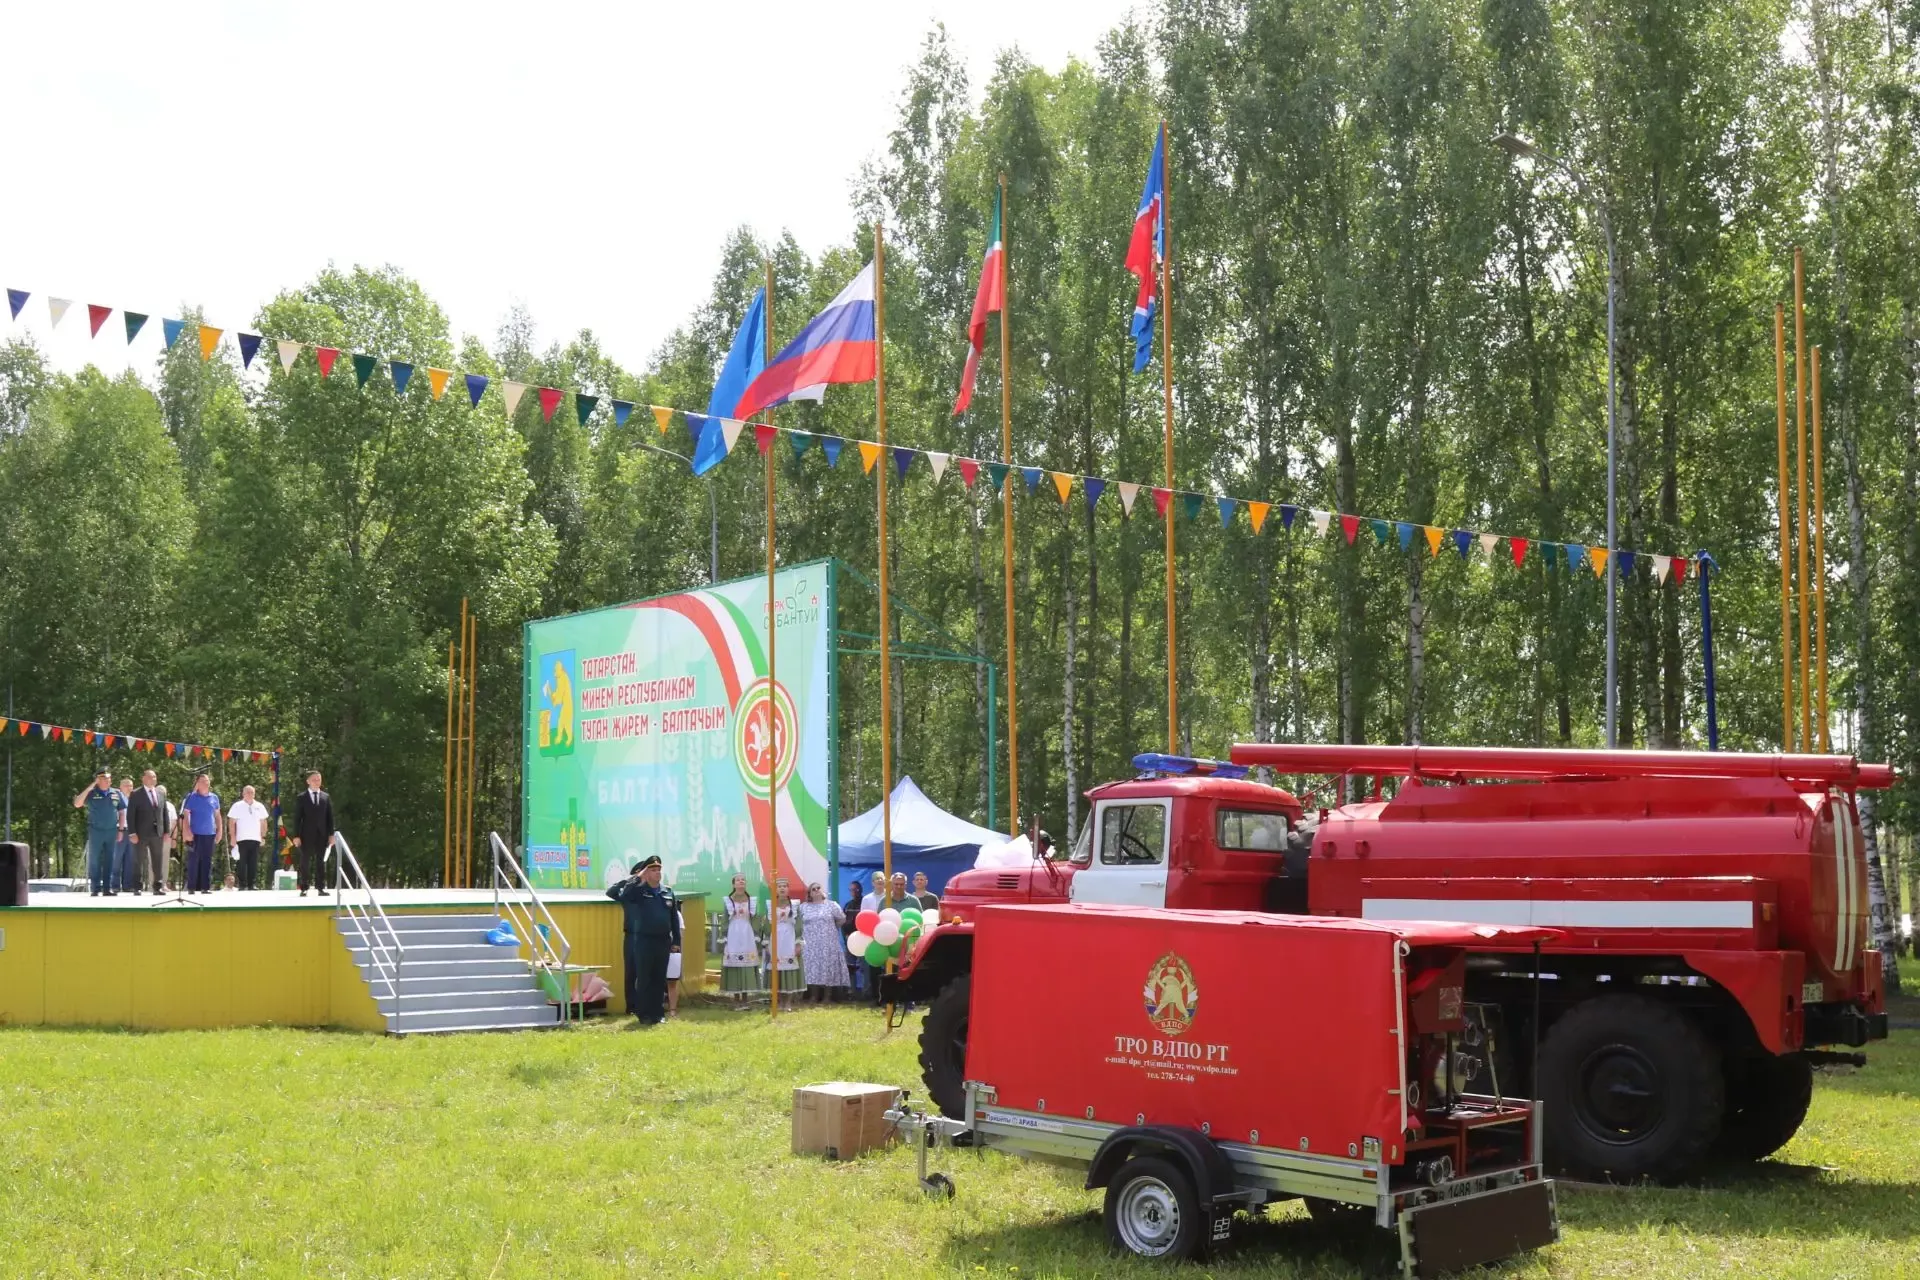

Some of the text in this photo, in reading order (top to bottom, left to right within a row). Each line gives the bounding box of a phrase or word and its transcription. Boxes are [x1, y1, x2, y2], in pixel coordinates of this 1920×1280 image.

[764, 600, 785, 613] ПРК
[582, 676, 695, 710] МИНЕМ РЕСПУБЛИКАМ
[581, 718, 608, 741] ТУГАН
[662, 706, 725, 734] БАЛТАЧЫМ
[1161, 1021, 1183, 1030] ВДПО
[1115, 1036, 1229, 1062] ТРО ВДПО РТ
